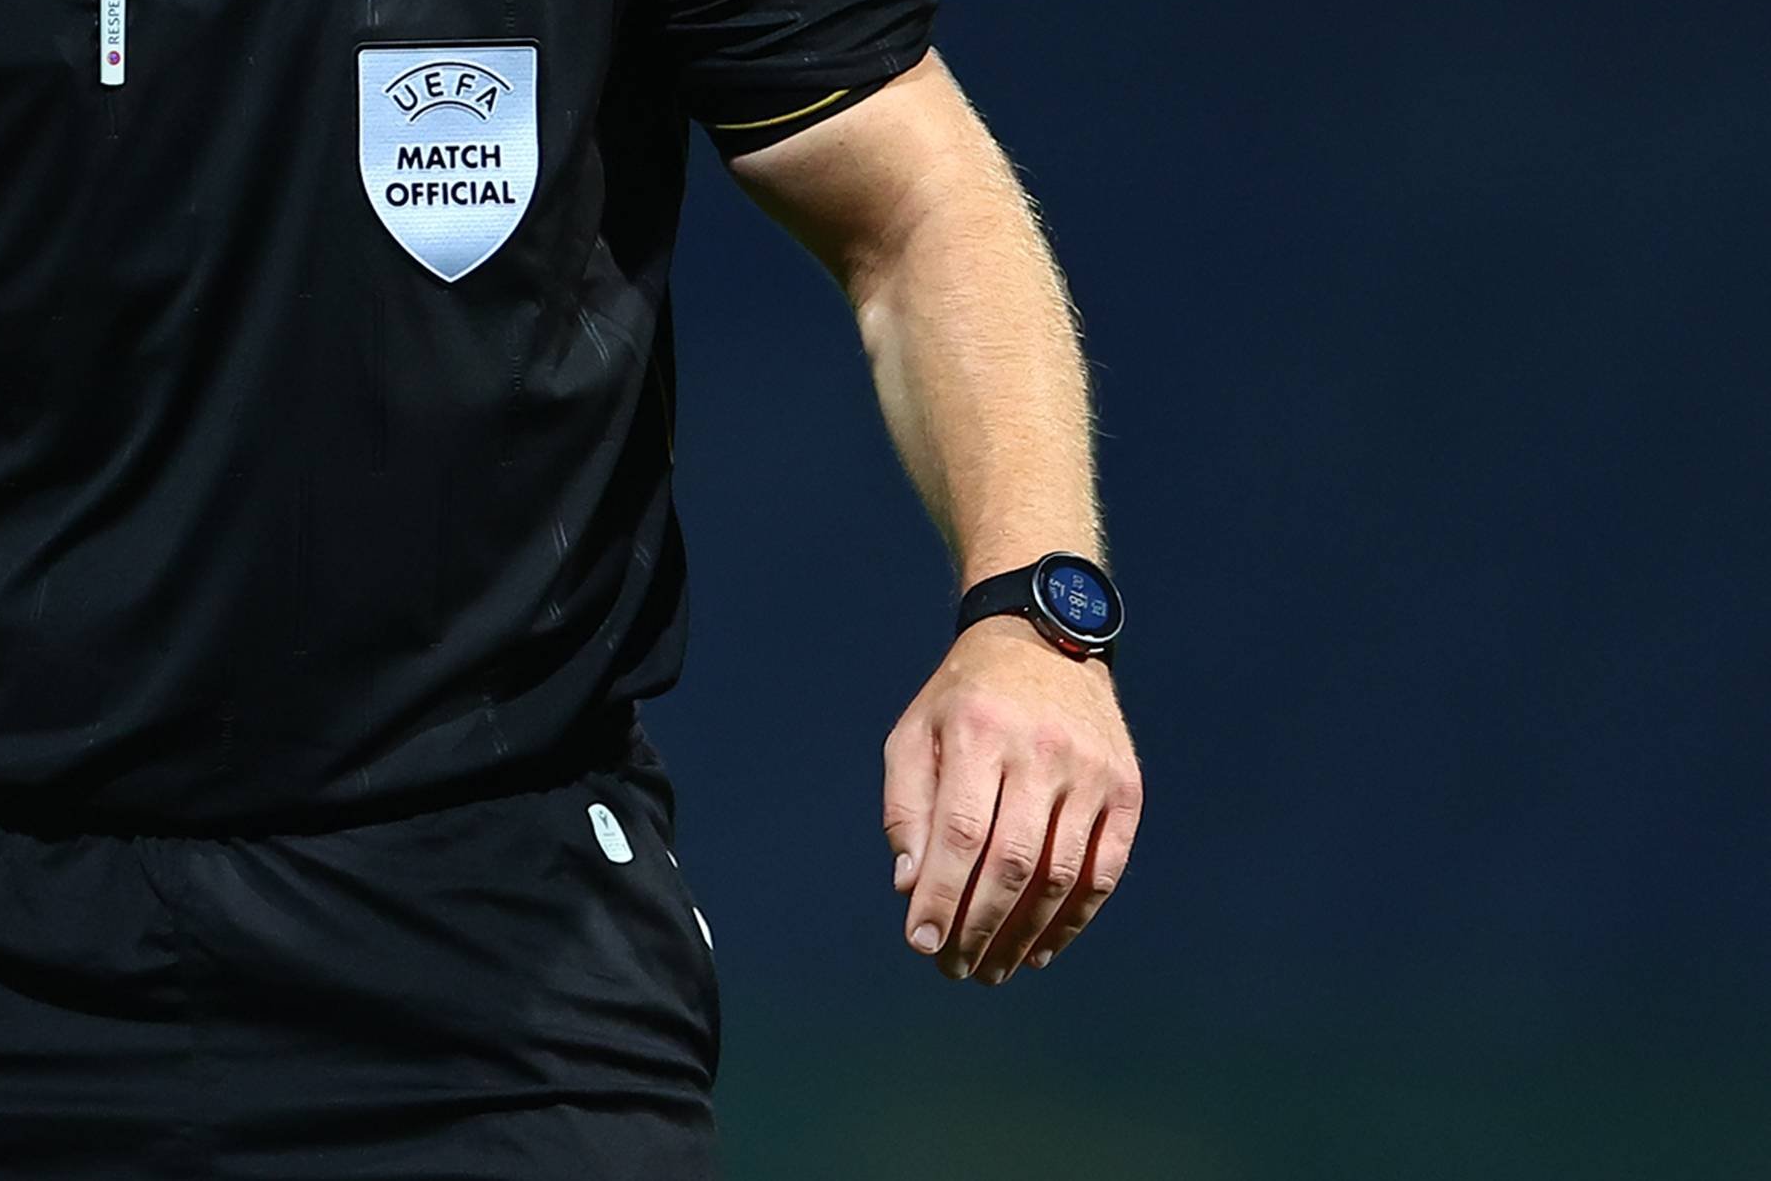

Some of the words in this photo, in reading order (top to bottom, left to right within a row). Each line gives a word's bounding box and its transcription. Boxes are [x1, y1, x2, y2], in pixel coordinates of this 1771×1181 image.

[393, 72, 498, 112] UEFA
[397, 144, 501, 170] MATCH
[385, 180, 516, 207] OFFICIAL
